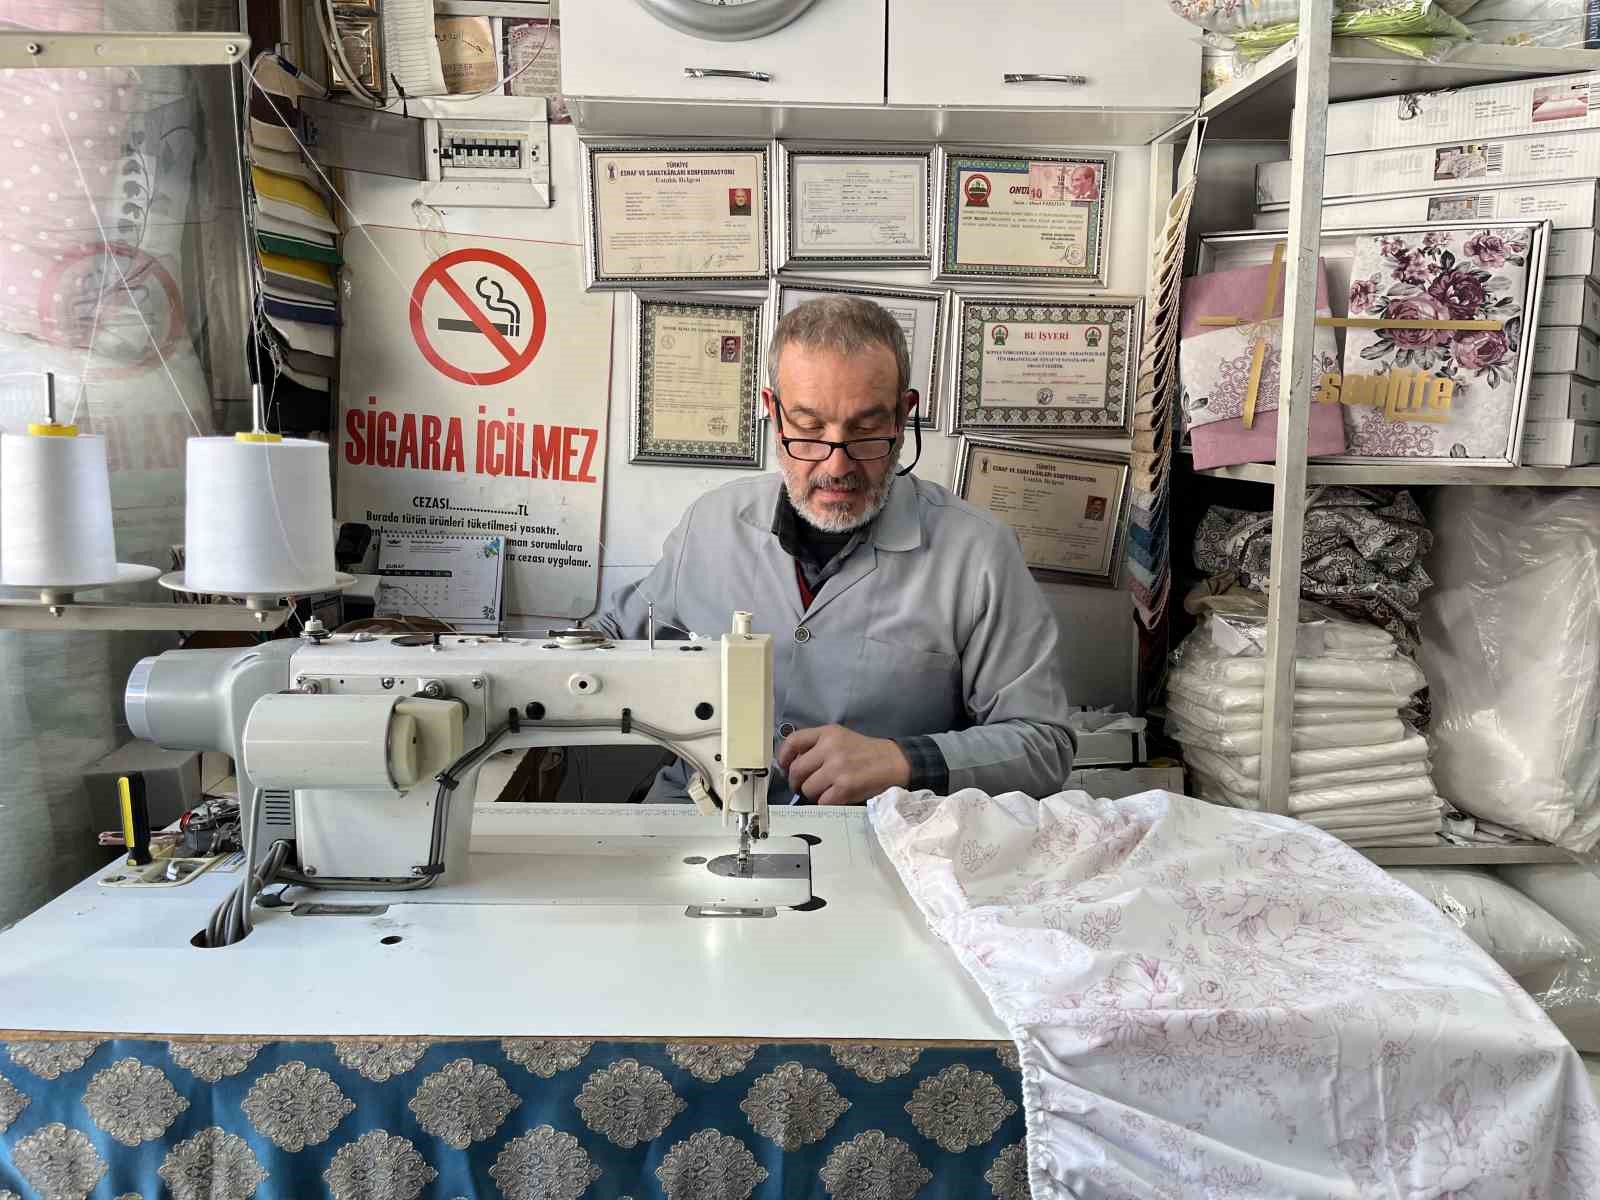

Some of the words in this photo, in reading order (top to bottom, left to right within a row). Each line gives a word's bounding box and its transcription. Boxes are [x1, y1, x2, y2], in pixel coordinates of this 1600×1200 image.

[344, 396, 466, 473] SİGARA
[474, 404, 599, 484] İÇİLMEZ
[366, 511, 399, 524] Burada
[401, 513, 427, 526] tütün
[429, 514, 465, 529] ürünleri
[467, 517, 518, 533] tüketilmesi
[519, 524, 560, 536] yasaktır.
[530, 540, 583, 553] sorumlulara
[518, 554, 545, 564] cezası
[547, 556, 592, 569] uygulanır.
